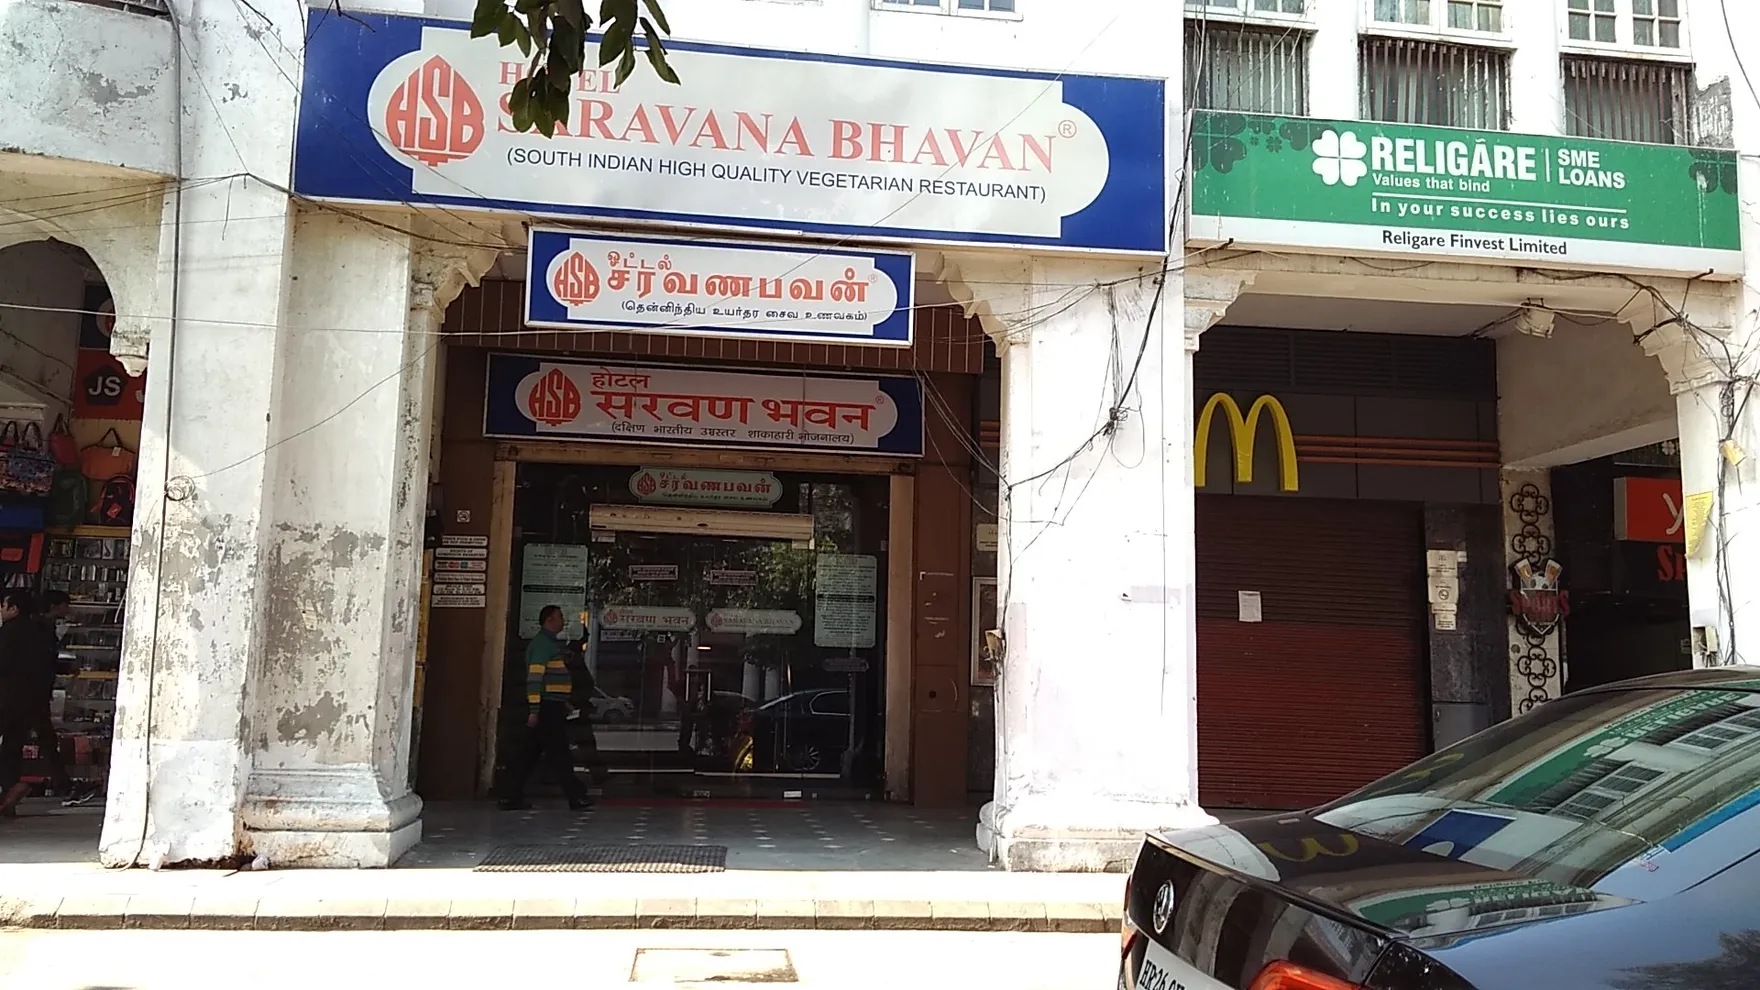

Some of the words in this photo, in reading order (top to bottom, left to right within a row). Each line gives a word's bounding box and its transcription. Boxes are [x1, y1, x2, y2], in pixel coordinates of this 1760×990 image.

[499, 61, 620, 94] HEL
[828, 118, 1057, 174] BHAVAN
[1557, 148, 1600, 169] SME
[507, 147, 582, 169] (SOUTH
[588, 152, 653, 173] INDIAN
[659, 158, 706, 178] HIGH
[711, 163, 792, 184] QUALITY
[796, 171, 913, 193] VEGETARIAN
[919, 179, 1046, 204] RESTAURANT)
[1372, 172, 1421, 188] Values
[1426, 176, 1454, 190] that
[1459, 179, 1491, 193] bind
[1558, 168, 1626, 189] LOANS
[1371, 197, 1391, 213] In
[1398, 201, 1444, 218] your
[1450, 204, 1535, 222] success
[1542, 208, 1580, 226] lies
[1585, 214, 1630, 230] ours
[1382, 229, 1446, 250] Religare
[1450, 233, 1505, 251] Finvest
[1508, 236, 1568, 255] Limited
[88, 375, 121, 397] JS
[590, 366, 652, 390] होटल
[590, 391, 755, 425] सरवण
[761, 398, 876, 431] भवन
[653, 423, 693, 436] भारतीय
[747, 428, 794, 441] शाकाहारी
